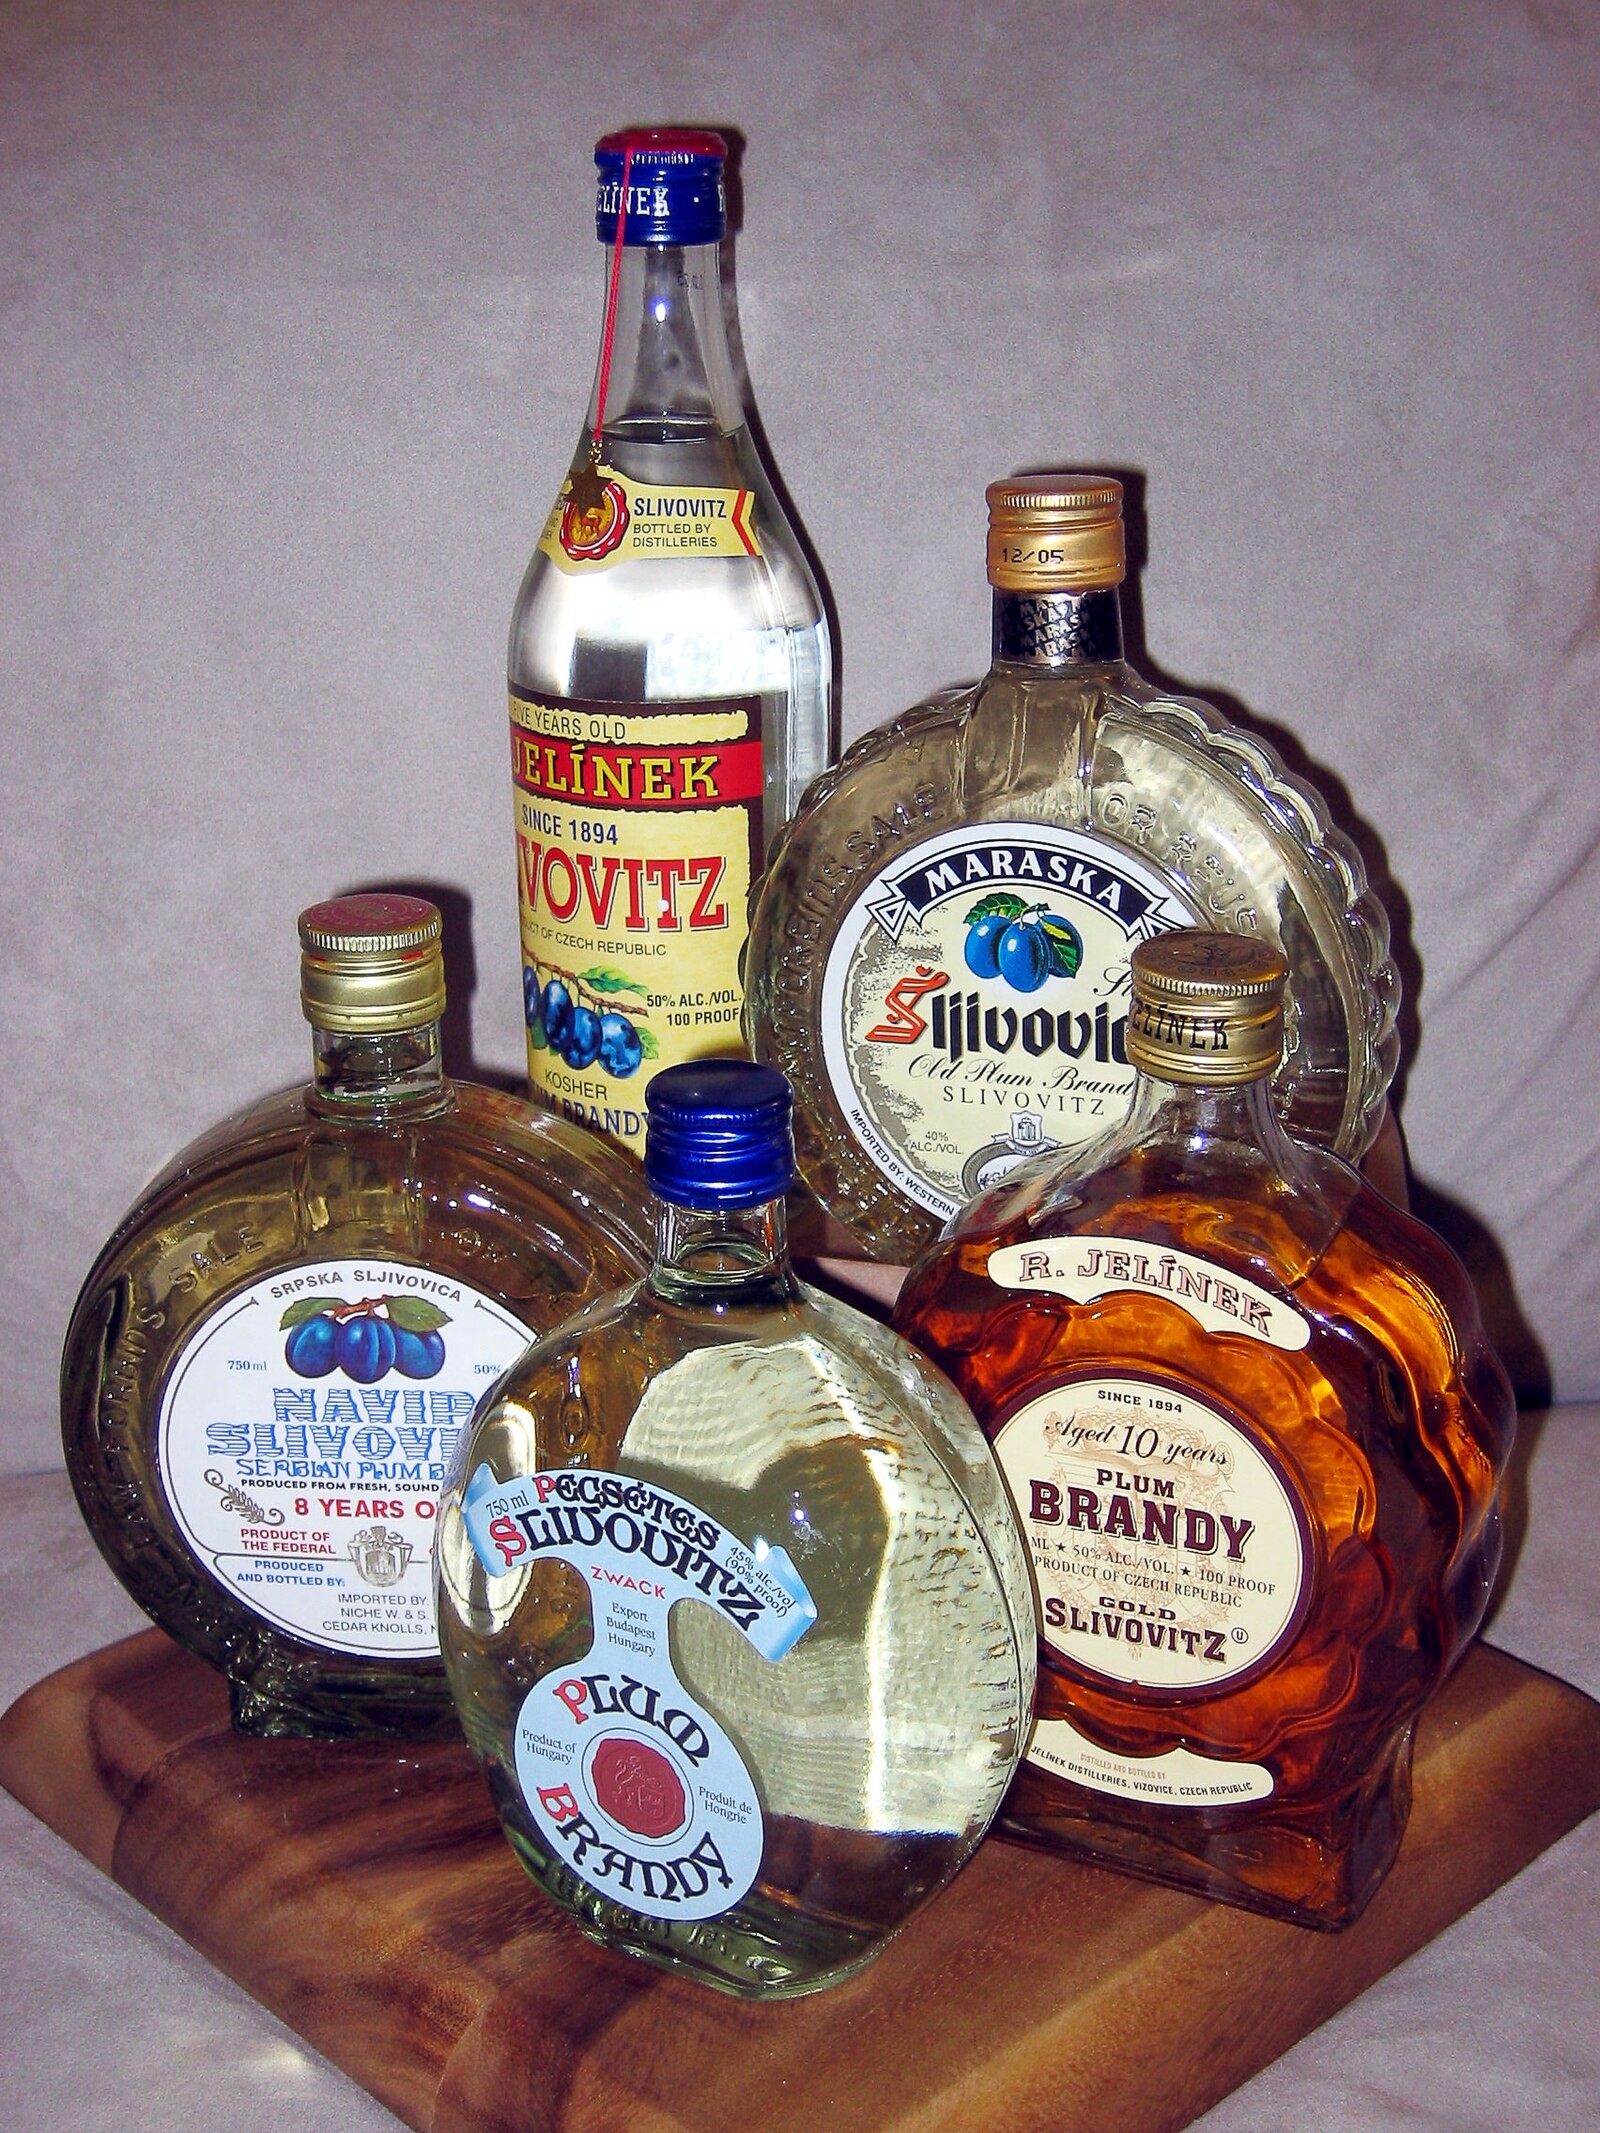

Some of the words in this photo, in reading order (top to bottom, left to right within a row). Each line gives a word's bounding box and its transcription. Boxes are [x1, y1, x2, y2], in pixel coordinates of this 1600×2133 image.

[598, 181, 670, 216] LÍNEK
[634, 497, 727, 519] SLIVOVITZ
[633, 523, 691, 534] BOTTLED
[695, 524, 711, 534] BY
[633, 536, 718, 548] DISTILLERIES
[1001, 548, 1065, 564] 12/05
[534, 710, 582, 736] YEARS
[589, 719, 626, 740] OLD
[513, 735, 719, 801] JELÍNEK
[522, 803, 562, 838] SINCE
[569, 819, 618, 846] 1894
[925, 850, 1123, 912] MARASKA
[541, 927, 553, 940] OF
[555, 932, 594, 951] CZECH
[597, 940, 667, 956] REPUBLIC
[647, 994, 676, 1008] 50%
[667, 1013, 690, 1026] 100
[695, 1007, 740, 1024] PROOF
[544, 1069, 608, 1100] KOSHER
[908, 1054, 958, 1081] Old
[965, 1059, 1034, 1087] Plum
[1042, 1065, 1135, 1097] Brand
[943, 1085, 1105, 1116] SLIVOVITZ
[925, 1131, 949, 1142] 40%
[851, 1109, 890, 1163] IMPORTED
[888, 1162, 905, 1180] BY:
[905, 1177, 955, 1215] WESTERN
[270, 1271, 344, 1299] SRPSKA
[353, 1269, 462, 1302] SLJIVOVICA
[1019, 1251, 1064, 1281] R.
[1077, 1249, 1273, 1337] JELÍNEK
[227, 1360, 251, 1371] 750
[253, 1360, 267, 1371] ml
[474, 1364, 501, 1375] 50%
[273, 1388, 476, 1424] NAVIP
[1098, 1389, 1141, 1406] SINCE
[1149, 1399, 1183, 1413] 1894
[1045, 1413, 1116, 1446] Aged
[1116, 1424, 1159, 1458] 10
[1163, 1441, 1229, 1465] years
[236, 1459, 350, 1479] SERBIAN
[357, 1462, 418, 1480] PLUM
[241, 1479, 307, 1489] PRODUCED
[311, 1481, 346, 1491] FROM
[350, 1482, 391, 1493] FRESH,
[395, 1483, 439, 1492] SOUND
[1097, 1468, 1175, 1498] PLUM
[294, 1498, 309, 1516] 8
[318, 1498, 405, 1519] YEARS
[486, 1496, 509, 1520] 750
[510, 1490, 530, 1511] ml
[1029, 1479, 1255, 1562] BRANDY
[240, 1529, 307, 1541] PRODUCT
[312, 1531, 330, 1542] OF
[241, 1540, 269, 1551] THE
[273, 1542, 336, 1554] FEDERAL
[254, 1560, 324, 1572] PRODUCED
[489, 1506, 766, 1631] SLIVOVITZ
[730, 1546, 754, 1570] 45%
[755, 1569, 797, 1609] alc./vol
[1031, 1536, 1050, 1550] ML
[1073, 1544, 1101, 1560] 50%
[1200, 1570, 1223, 1585] 100
[1228, 1576, 1276, 1596] PROOF
[237, 1573, 263, 1583] AND
[266, 1574, 323, 1586] BOTTLED
[591, 1566, 665, 1599] ZWACK
[1034, 1556, 1099, 1579] PRODUCT
[1102, 1569, 1119, 1582] OF
[1124, 1573, 1169, 1593] CZECH
[1174, 1583, 1243, 1608] REPUBLIC
[338, 1594, 406, 1605] IMPORTED
[612, 1602, 648, 1622] Export
[753, 1585, 788, 1618] proof)
[1099, 1596, 1176, 1621] GOLD
[322, 1621, 367, 1632] CEDAR
[341, 1608, 381, 1619] NICHE
[405, 1610, 413, 1620] &
[606, 1616, 656, 1640] Budapest
[1045, 1597, 1227, 1662] SLIVOVITZ
[608, 1632, 656, 1658] Hungary
[522, 1729, 562, 1750] Product
[565, 1742, 577, 1754] of
[526, 1741, 572, 1765] Hungary
[1080, 1753, 1111, 1770] DISTILLED
[1127, 1766, 1156, 1779] BOTTLED
[699, 1786, 737, 1809] Produit
[739, 1803, 752, 1815] de
[1179, 1786, 1208, 1796] CZECH
[1210, 1781, 1253, 1796] REPUBLIC
[704, 1801, 747, 1824] Hongrie
[536, 1782, 734, 1902] BRANDY
